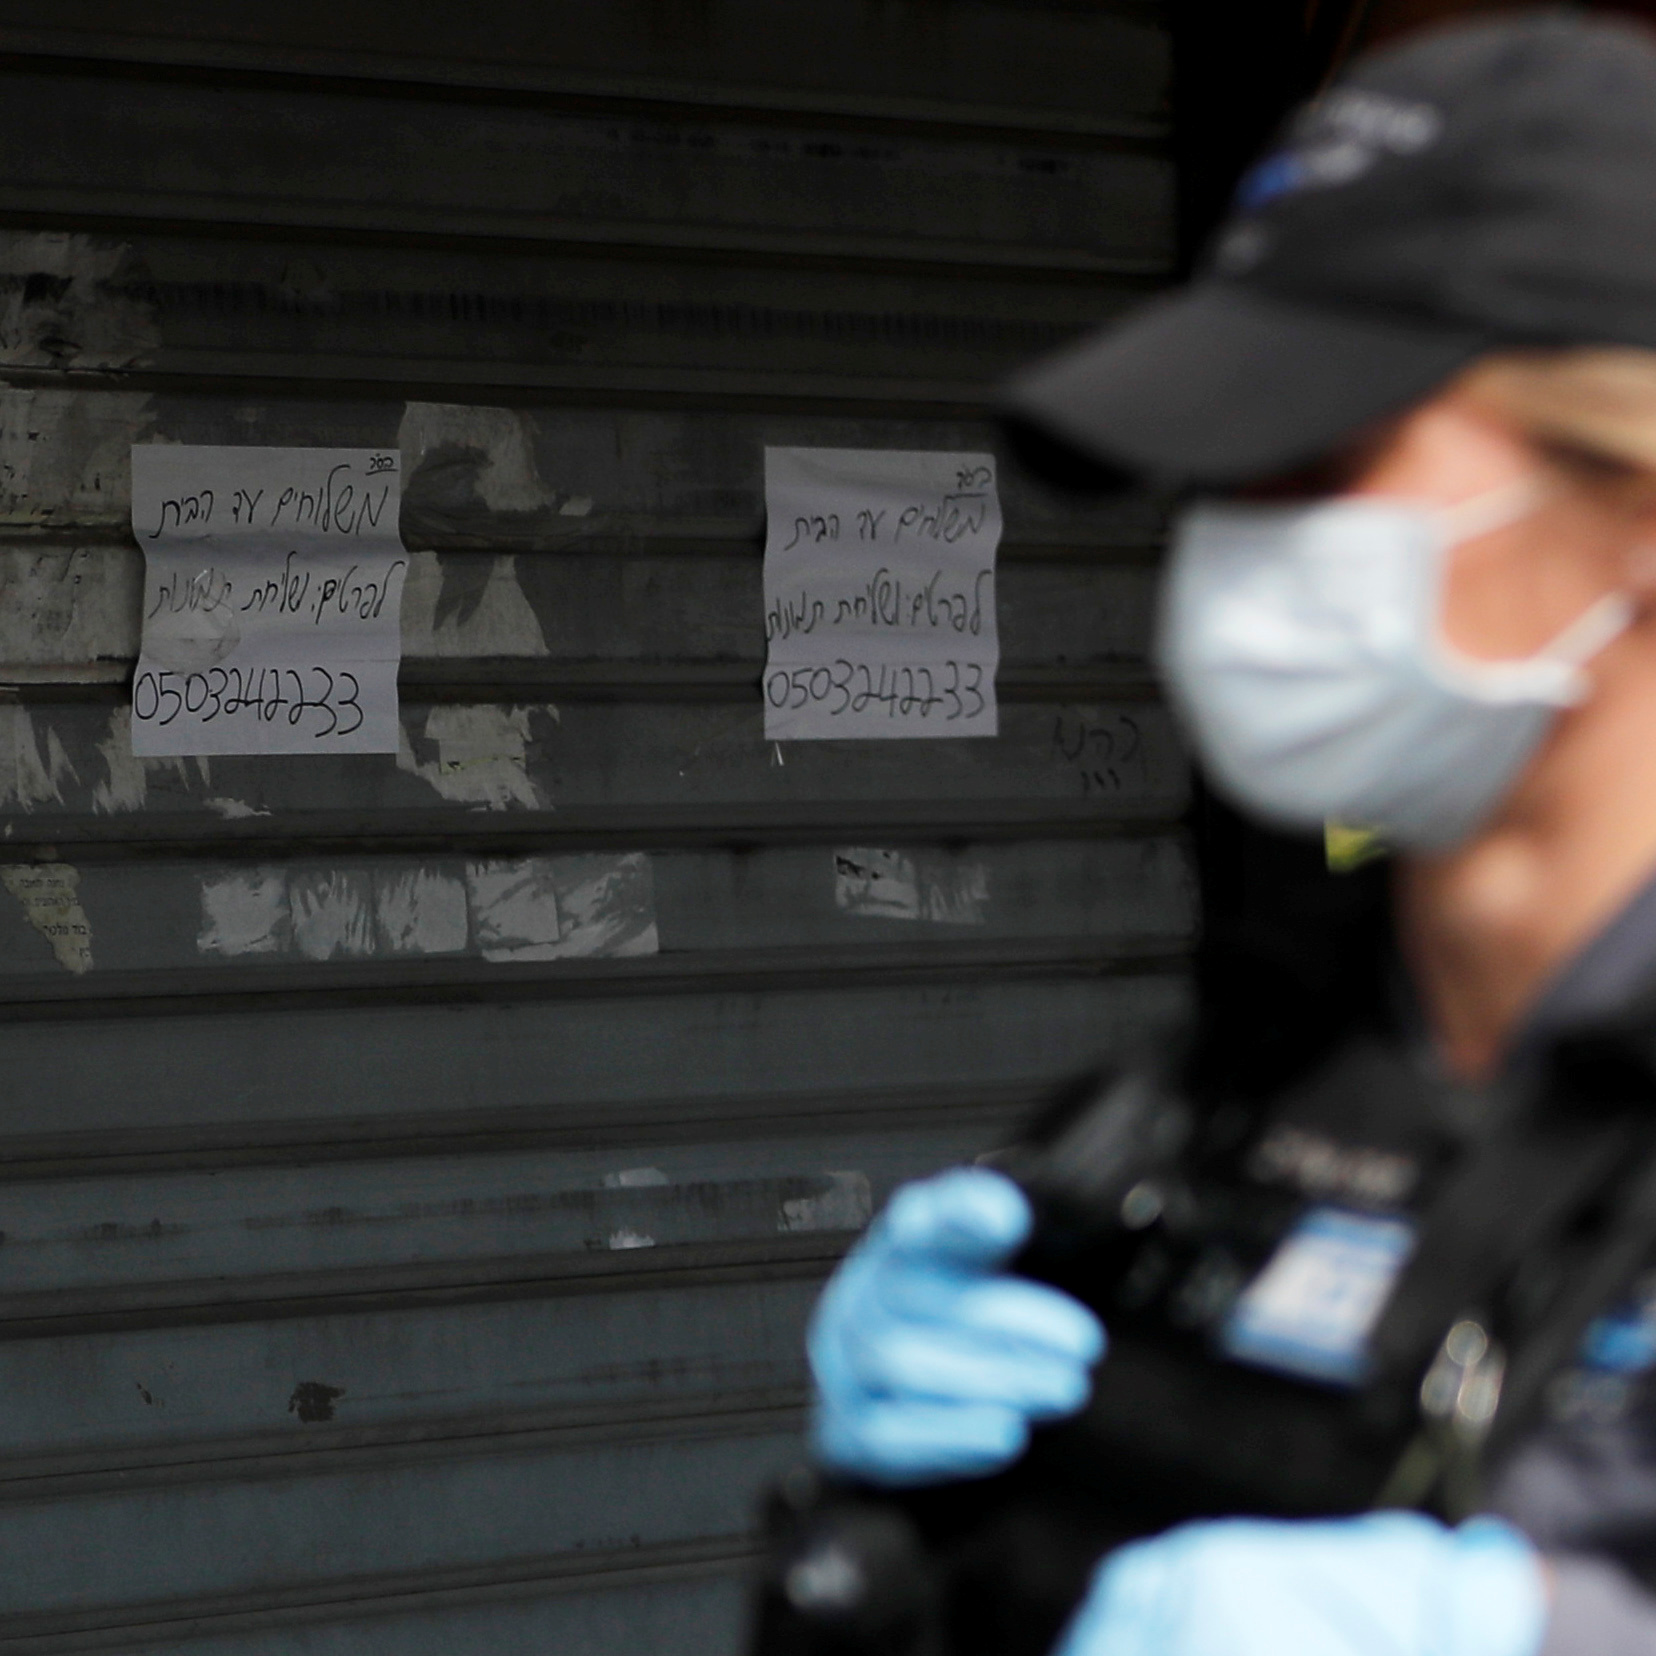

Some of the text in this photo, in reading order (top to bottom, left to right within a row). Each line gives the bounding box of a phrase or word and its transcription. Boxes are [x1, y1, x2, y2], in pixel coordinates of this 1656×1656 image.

[232, 488, 264, 525] עד
[134, 666, 364, 739] 0503242233
[766, 658, 985, 721] 0503242233
